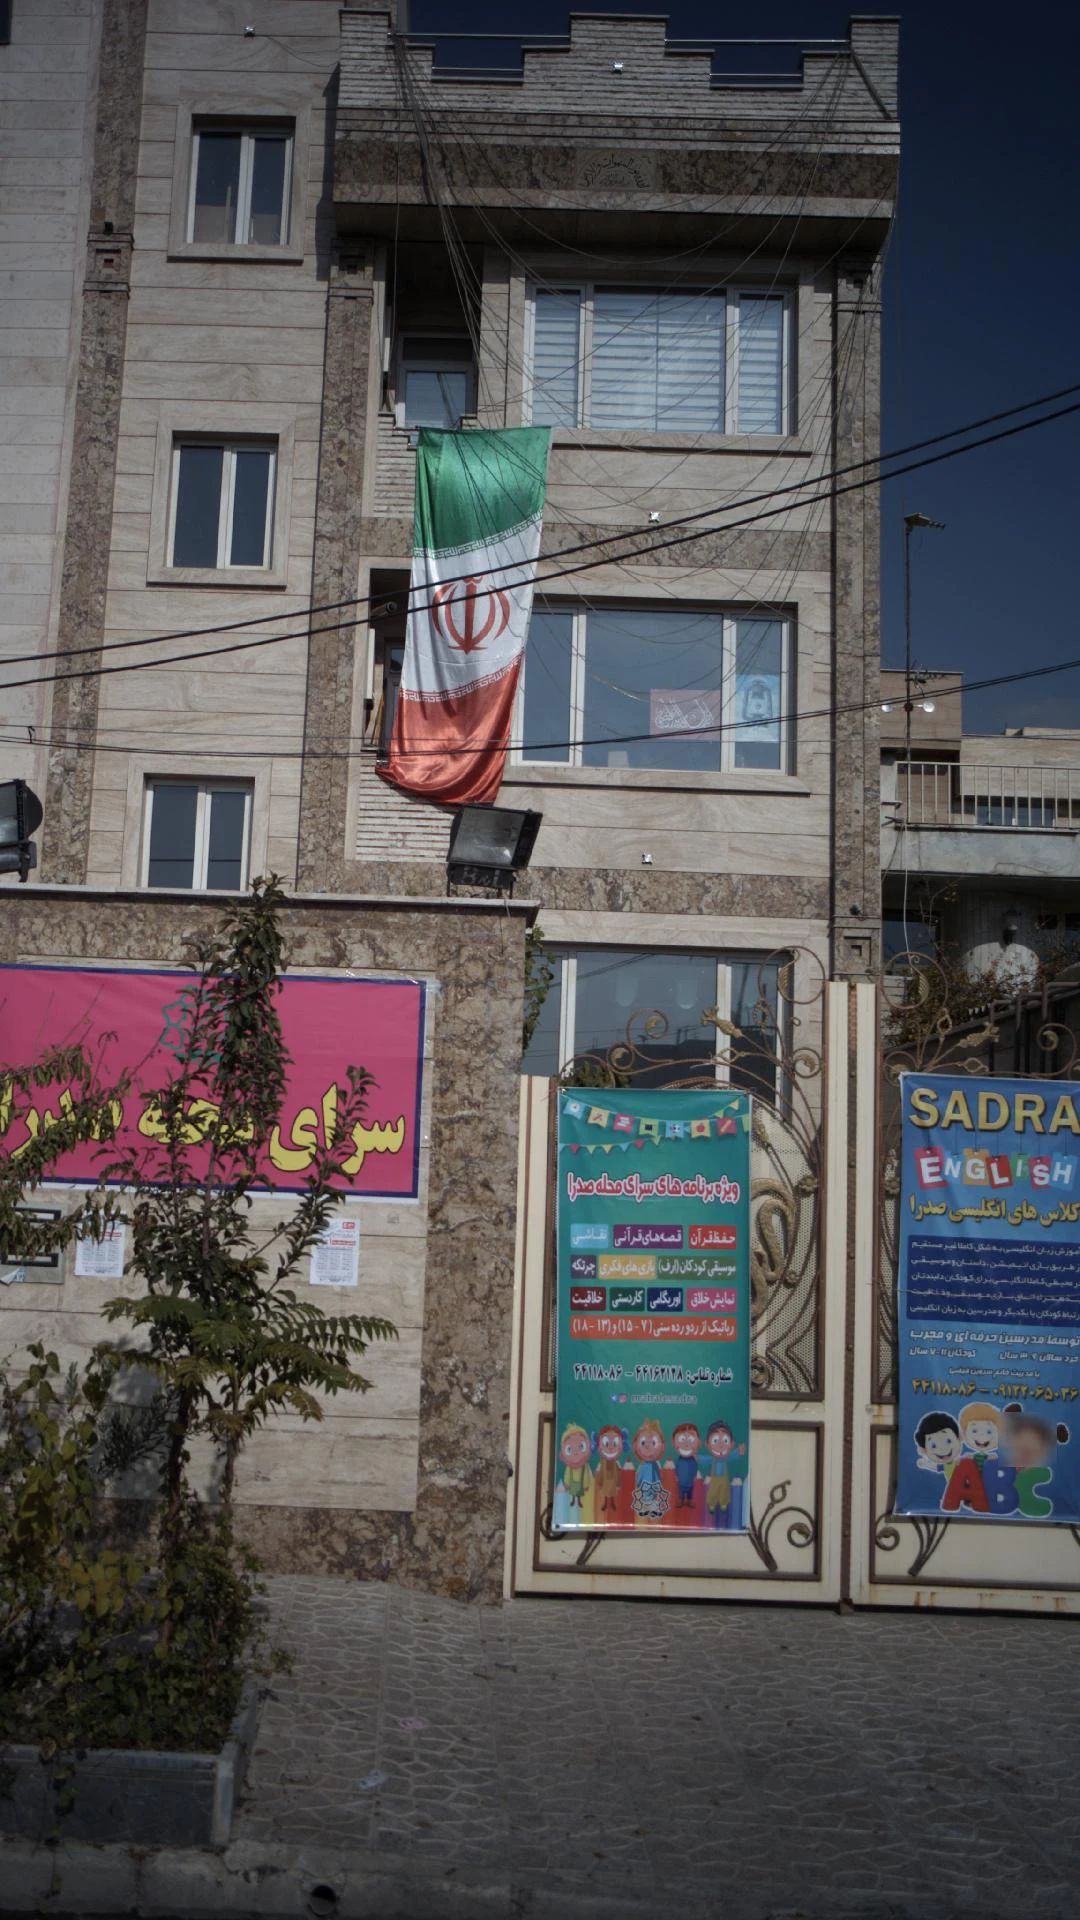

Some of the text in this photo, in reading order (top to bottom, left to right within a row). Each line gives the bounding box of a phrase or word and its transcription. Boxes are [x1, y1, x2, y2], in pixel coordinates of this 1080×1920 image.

[908, 1087, 1080, 1134] SADRA
[269, 1082, 405, 1175] سرای
[919, 1156, 1073, 1186] ENGLISH
[568, 1172, 740, 1204] ویژه برنامه های سرای محله صدرا
[909, 1193, 947, 1221] صدرا
[949, 1198, 1006, 1223] انگلیسی
[1007, 1200, 1038, 1225] های
[573, 1227, 608, 1245] نقاشی
[614, 1226, 642, 1247] قرآنی
[690, 1228, 736, 1246] حفظ قرآن
[571, 1258, 595, 1275] چرتکه
[680, 1259, 708, 1276] کودکان
[707, 1260, 736, 1277] موسیقی
[571, 1290, 603, 1307] خلاقیت
[690, 1291, 736, 1309] نمایش خلاق
[710, 1366, 733, 1387] شماره
